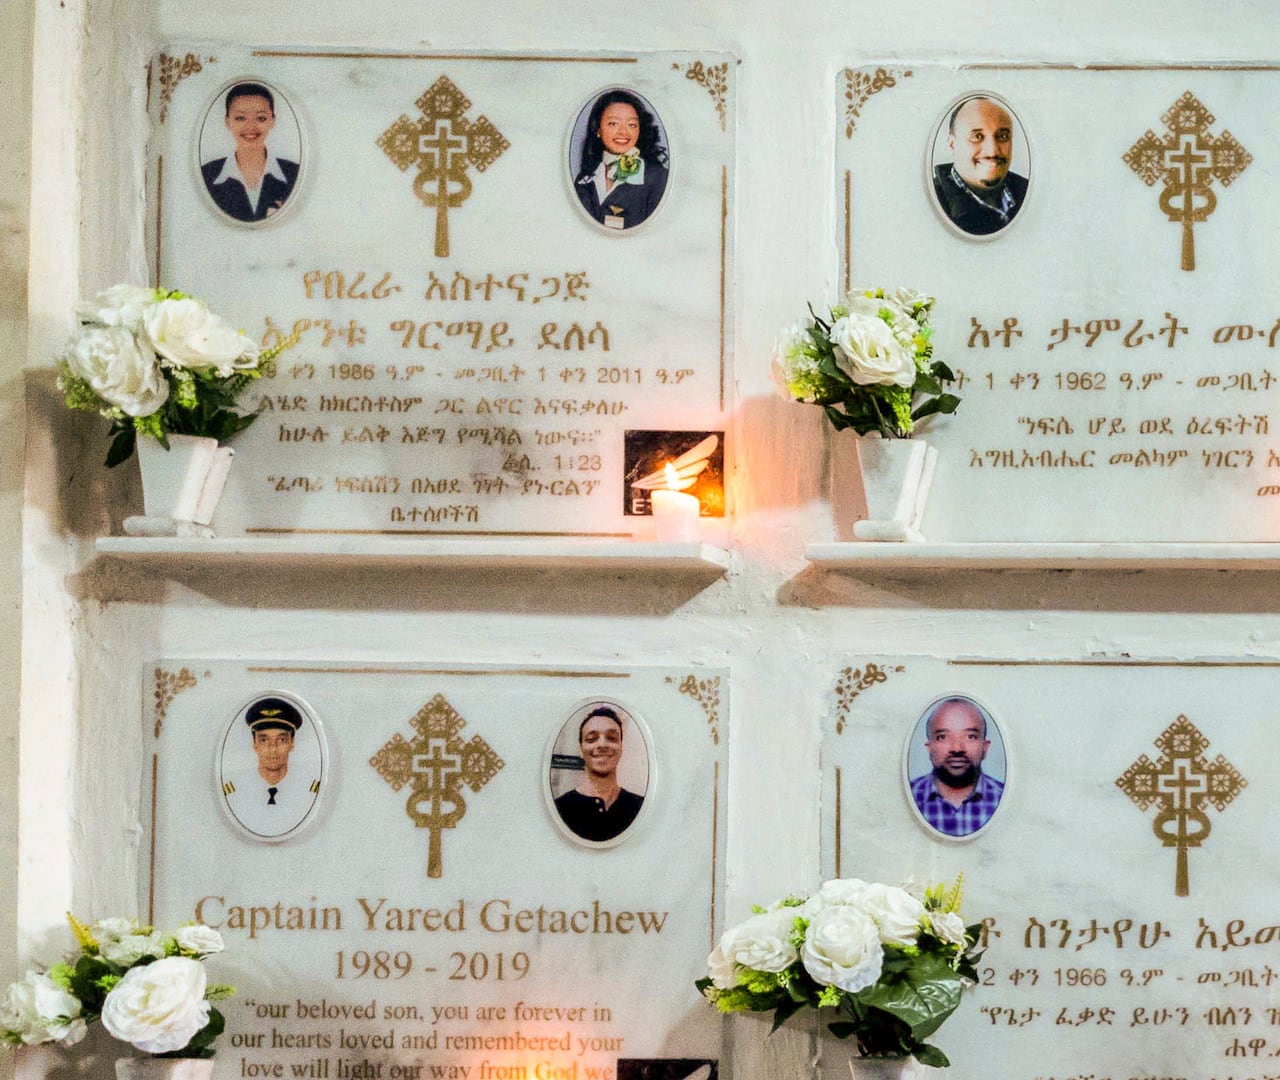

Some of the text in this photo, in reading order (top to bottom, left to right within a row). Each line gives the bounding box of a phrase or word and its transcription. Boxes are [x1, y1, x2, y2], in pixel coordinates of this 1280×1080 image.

[302, 269, 590, 305] የበረራ አስተናጋጅ
[389, 320, 515, 354] ግርማይ
[537, 321, 610, 352] ደለሳ
[967, 317, 1023, 349] አቶ
[1047, 311, 1189, 351] ታምራት
[1088, 416, 1126, 437] ሆይ
[1138, 417, 1174, 435] ወደ
[194, 896, 669, 940] Captain Yared Getachew
[1023, 916, 1171, 952] ስንታየሁ
[336, 951, 531, 982] 1989 2019
[295, 998, 376, 1021] beloved
[383, 1005, 424, 1021] son,
[431, 1005, 469, 1026] you
[476, 1006, 507, 1023] are
[512, 1000, 587, 1023] forever
[592, 1007, 612, 1023] in
[230, 1027, 625, 1059] our hearts loved and remembered your
